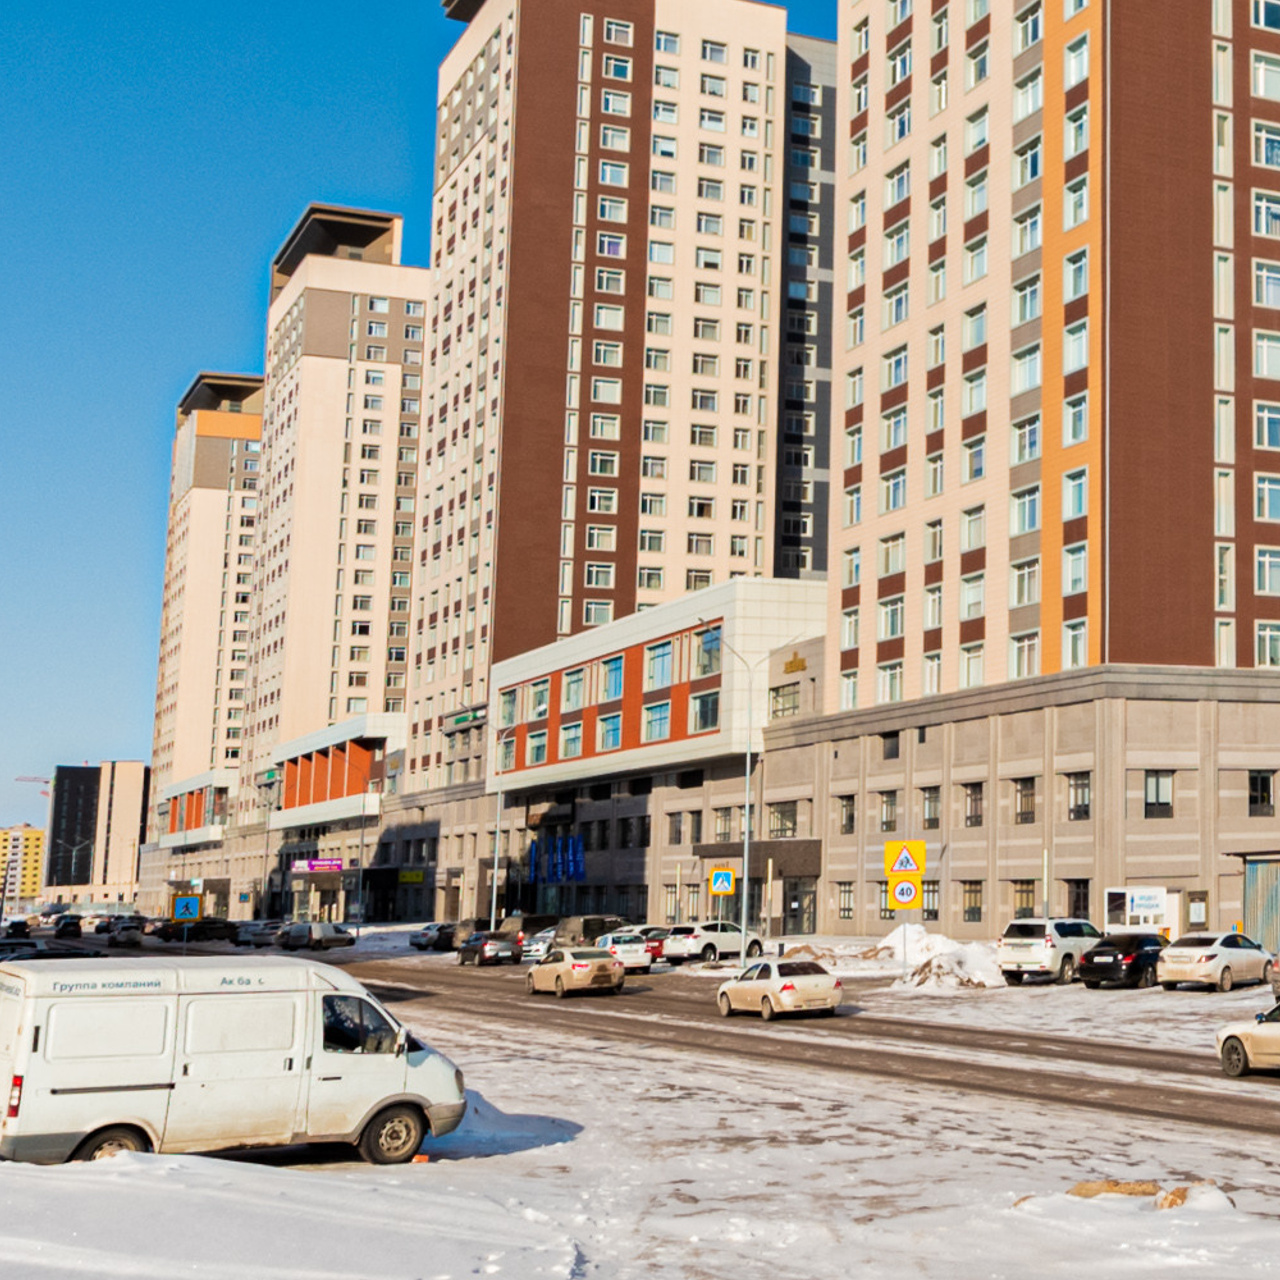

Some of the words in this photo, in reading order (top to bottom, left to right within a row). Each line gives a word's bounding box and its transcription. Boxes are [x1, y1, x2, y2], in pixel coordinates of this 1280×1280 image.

[898, 886, 913, 897] 40
[53, 981, 97, 992] Группа
[101, 979, 161, 989] компаний
